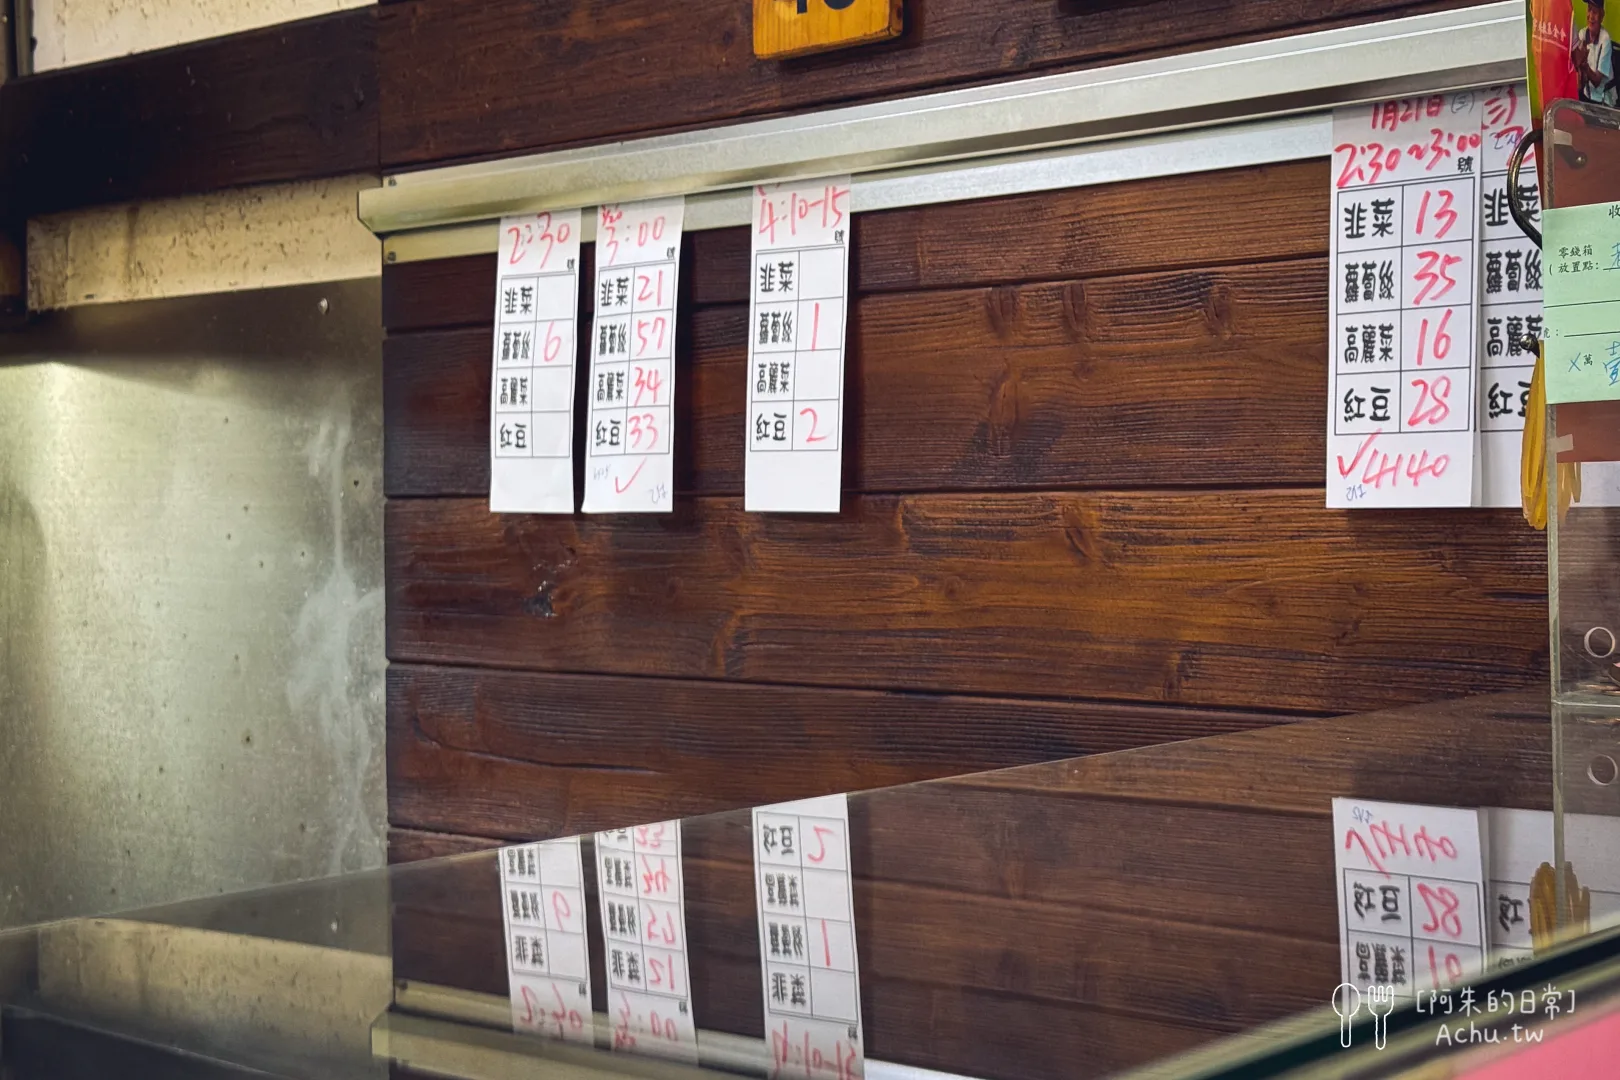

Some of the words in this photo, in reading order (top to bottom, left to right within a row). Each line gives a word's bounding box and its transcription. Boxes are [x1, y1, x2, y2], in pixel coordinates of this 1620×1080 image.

[1344, 198, 1395, 239] 韭菜
[1415, 190, 1458, 238] 13
[601, 277, 630, 307] 韭菜
[637, 269, 664, 307] 21
[760, 261, 794, 293] 韭菜
[1344, 260, 1394, 303] 蘿蔔絲
[1412, 250, 1463, 305] 35
[505, 285, 534, 315] 韭菜
[543, 321, 562, 362] 6
[636, 317, 666, 357] 57
[811, 302, 820, 352] 1
[1344, 323, 1394, 364] 高麗菜
[1415, 308, 1453, 366] 16
[634, 366, 662, 408] 34
[1343, 386, 1391, 423] 紅豆
[1407, 375, 1452, 427] 28
[500, 423, 527, 449] 紅豆
[595, 419, 621, 447] 紅豆
[628, 413, 658, 451] 33
[756, 412, 787, 441] 紅豆
[799, 407, 834, 442] 2
